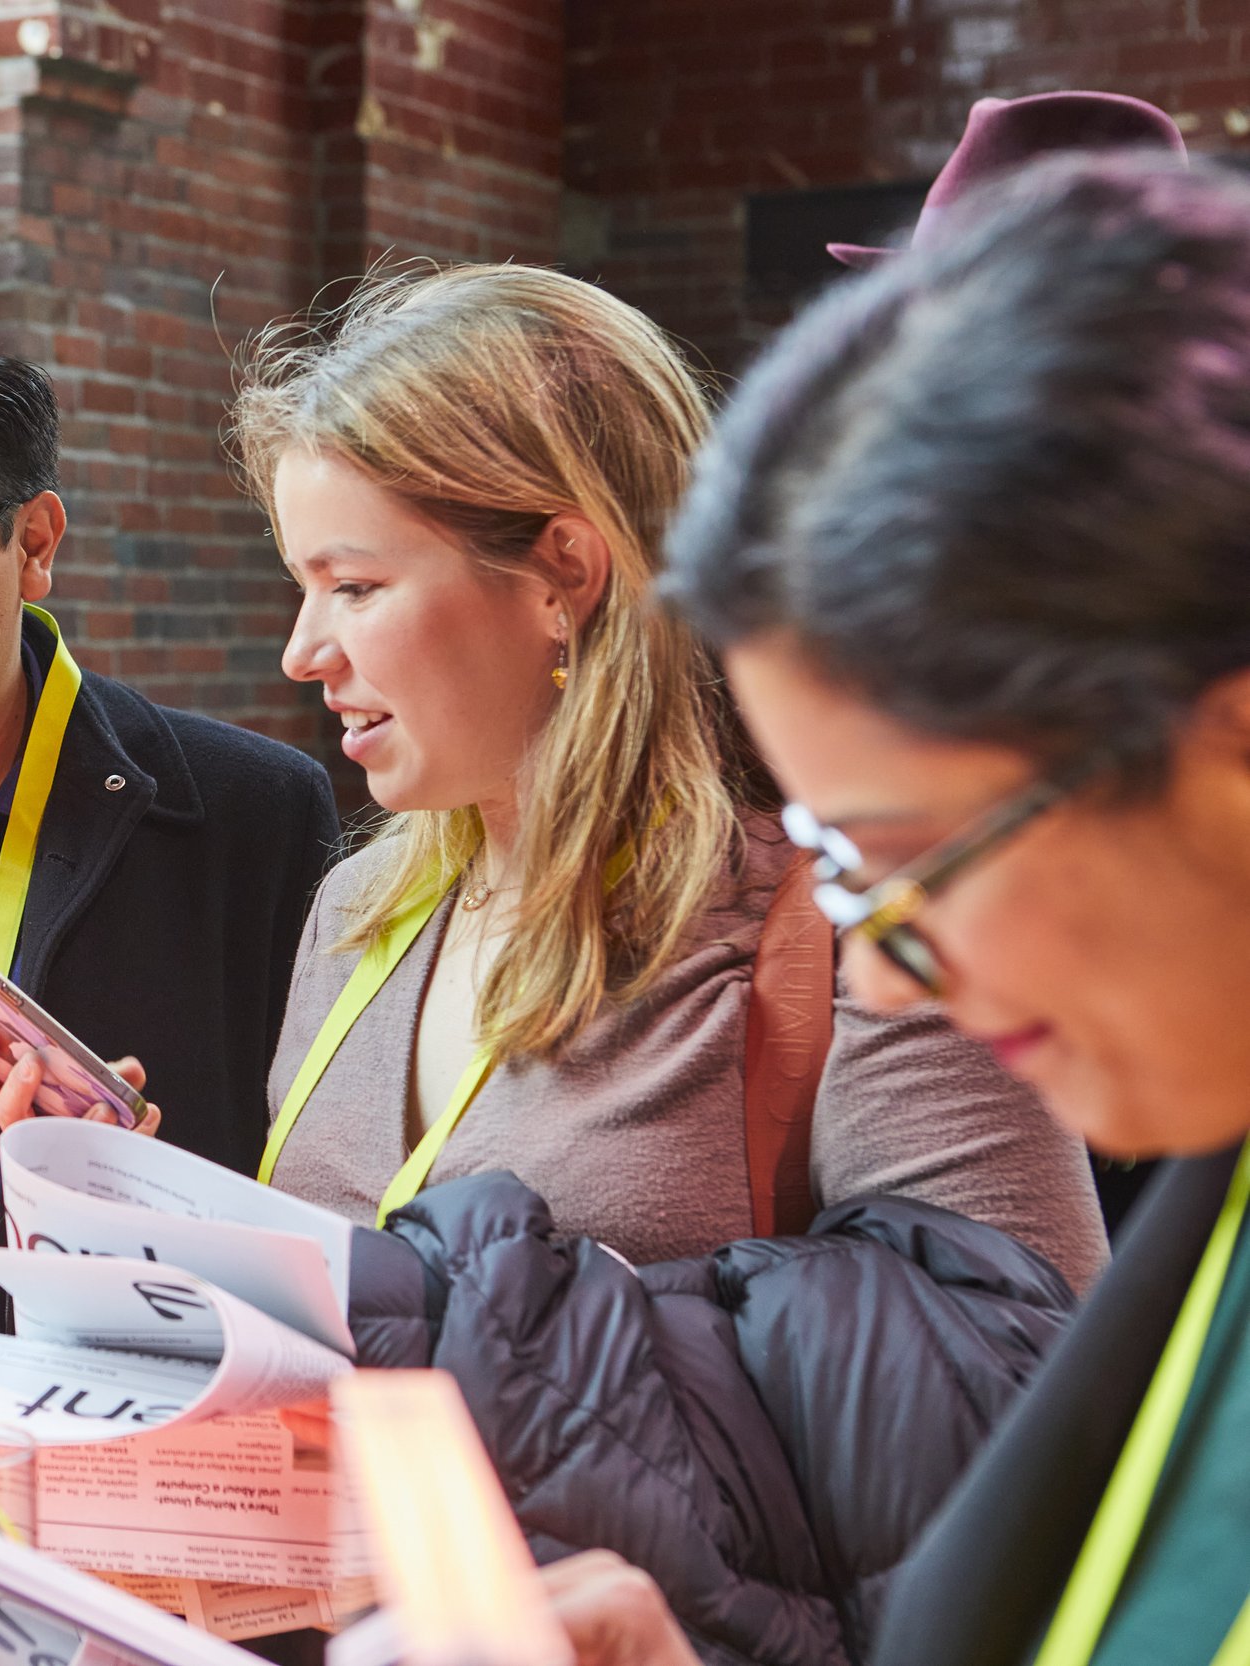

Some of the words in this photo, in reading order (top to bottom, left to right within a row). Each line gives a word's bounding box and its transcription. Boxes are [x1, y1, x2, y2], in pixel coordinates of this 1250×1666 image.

[156, 1480, 210, 1495] Computer
[223, 1485, 256, 1497] About
[258, 1486, 281, 1499] ural
[195, 1496, 237, 1511] Nothing
[240, 1501, 281, 1516] There's
